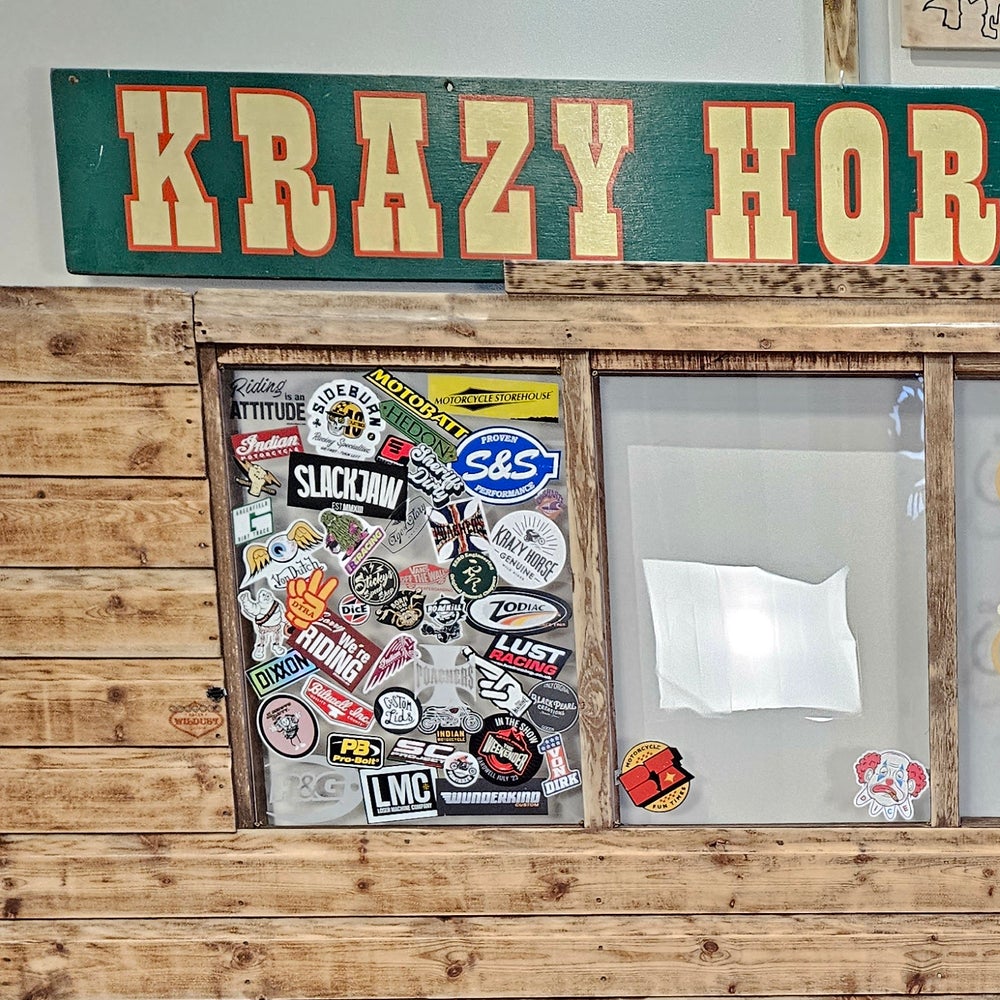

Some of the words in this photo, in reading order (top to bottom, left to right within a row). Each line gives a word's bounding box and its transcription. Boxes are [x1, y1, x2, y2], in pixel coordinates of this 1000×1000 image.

[116, 84, 633, 260] KRAZY
[231, 377, 287, 398] Riding
[435, 394, 493, 405] MOTORCYCLE
[494, 391, 552, 402] STOREHOUSE
[230, 401, 306, 421] ATTITUDE
[312, 384, 381, 427] SIDEBURN
[369, 369, 469, 439] MOTOBATT
[236, 433, 299, 456] Indian
[387, 406, 450, 460] HEDON
[481, 434, 518, 444] PROVEN
[462, 449, 540, 481] S&S
[294, 464, 403, 510] SLACKJAW
[474, 481, 535, 498] PERFORMANCE
[492, 525, 529, 557] KRAZY
[526, 548, 559, 582] HORSE
[499, 551, 535, 580] GENUINE
[291, 601, 315, 618] DTRA
[490, 600, 546, 622] ZODIAC
[295, 627, 363, 684] RIDING
[489, 649, 558, 675] RACING
[495, 635, 566, 664] LUST
[256, 652, 310, 689] DIXXON
[308, 679, 348, 711] Biltwell
[494, 717, 504, 726] IN
[505, 717, 520, 728] THE
[519, 722, 539, 744] SHOW
[340, 738, 370, 756] PB
[395, 740, 454, 757] SC
[482, 735, 528, 771] WEEKENDER
[625, 744, 662, 768] MOTORCYCLE
[547, 748, 566, 778] VON
[372, 772, 431, 807] LMC
[544, 772, 579, 793] DIRK
[670, 786, 686, 806] TIMES
[440, 791, 541, 804] WUNDERKIND
